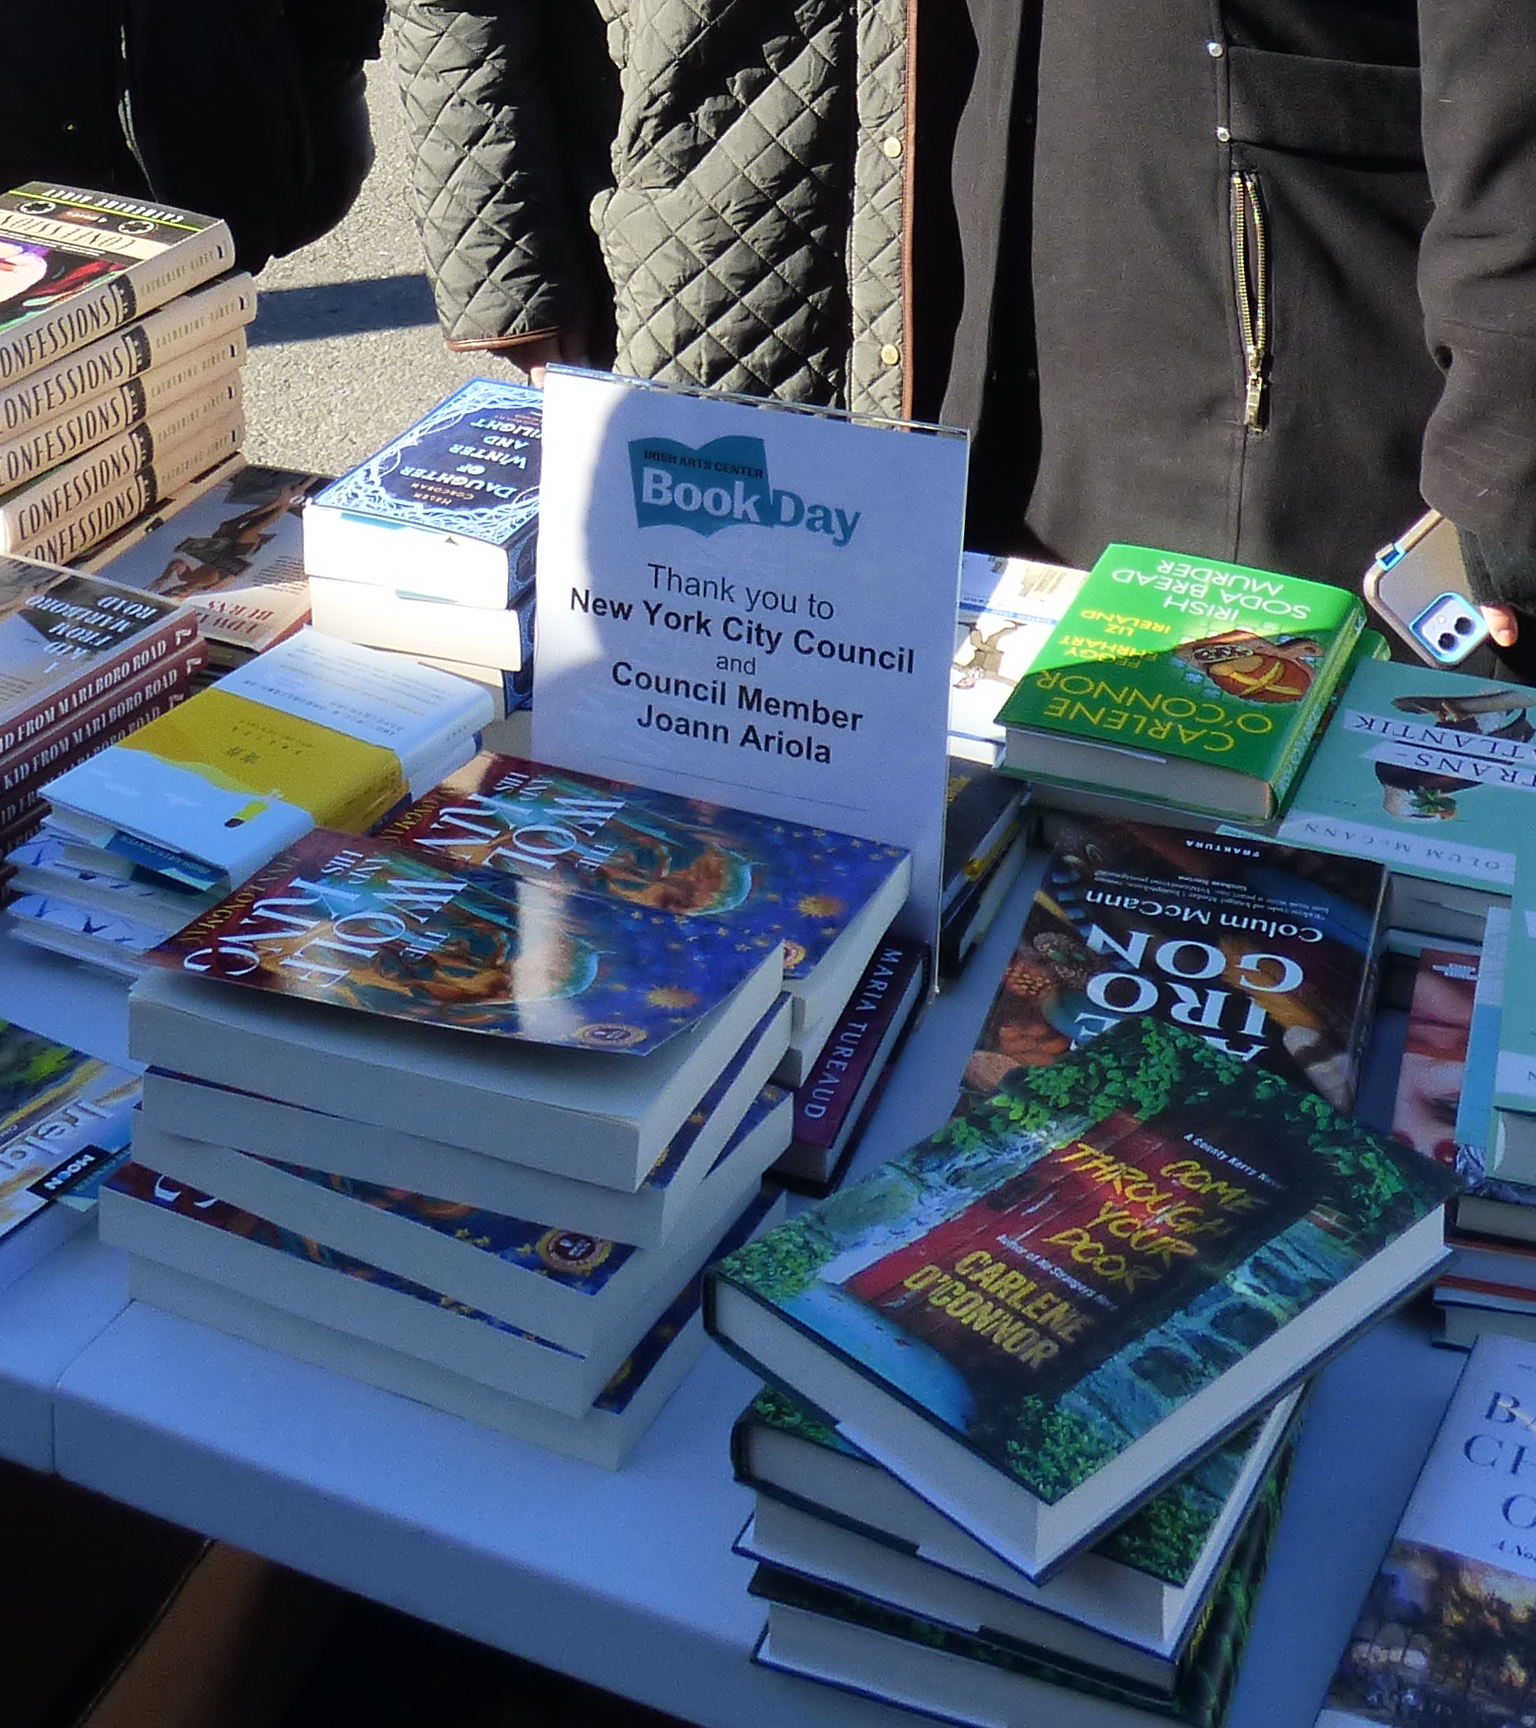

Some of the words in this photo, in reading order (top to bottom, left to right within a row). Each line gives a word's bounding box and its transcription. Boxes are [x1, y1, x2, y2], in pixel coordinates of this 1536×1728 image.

[448, 443, 529, 470] WINTER
[483, 434, 530, 450] AND
[399, 465, 518, 499] DAUGHTER
[455, 463, 486, 475] OF
[644, 448, 678, 467] IRISH
[680, 454, 713, 472] ARTS
[715, 459, 765, 479] CENTER
[18, 444, 133, 541] CONFESSIONS
[641, 467, 764, 527] Book
[766, 491, 862, 548] Day
[648, 563, 736, 605] Thank
[744, 582, 801, 621] you
[807, 588, 835, 620] to
[1111, 567, 1211, 600] BREAD
[1158, 557, 1286, 597] MURDER
[24, 594, 137, 634] MARLBORO
[96, 595, 158, 621] ROAD
[1162, 594, 1241, 622] IRISH
[1214, 584, 1312, 621] SODA
[48, 623, 115, 648] FROM
[569, 587, 634, 622] New
[642, 599, 713, 638] York
[721, 614, 784, 655] City
[793, 627, 915, 675] Council
[1080, 608, 1172, 636] IRELAND
[1108, 622, 1136, 639] LIZ
[43, 640, 92, 660] KID
[715, 648, 758, 676] and
[17, 706, 56, 743] FROM
[58, 661, 132, 721] MARLBORO
[132, 639, 168, 677] ROAD
[611, 660, 728, 706] Council
[736, 683, 864, 732] Member
[1035, 668, 1275, 736] O'CONNOR
[32, 738, 72, 773] FROM
[71, 692, 144, 748] MARLBORO
[145, 668, 179, 703] ROAD
[636, 703, 731, 744] Joann
[740, 723, 833, 765] Ariola
[1044, 697, 1238, 754] CARLENE
[1184, 838, 1261, 859] FRAKTURA
[1303, 822, 1411, 853] McCANN
[319, 848, 365, 877] HIS
[347, 854, 391, 886] AND
[1085, 890, 1221, 929] McCann
[1230, 905, 1325, 944] Colum
[399, 930, 452, 961] THE
[1085, 923, 1306, 995] GON
[852, 945, 905, 1011] MARIA
[801, 1013, 874, 1124] TUREAUD
[42, 1153, 96, 1191] MOON
[954, 1249, 1097, 1343] CARLENE
[903, 1263, 1061, 1370] O'CONNOR
[1494, 1539, 1507, 1552] A
